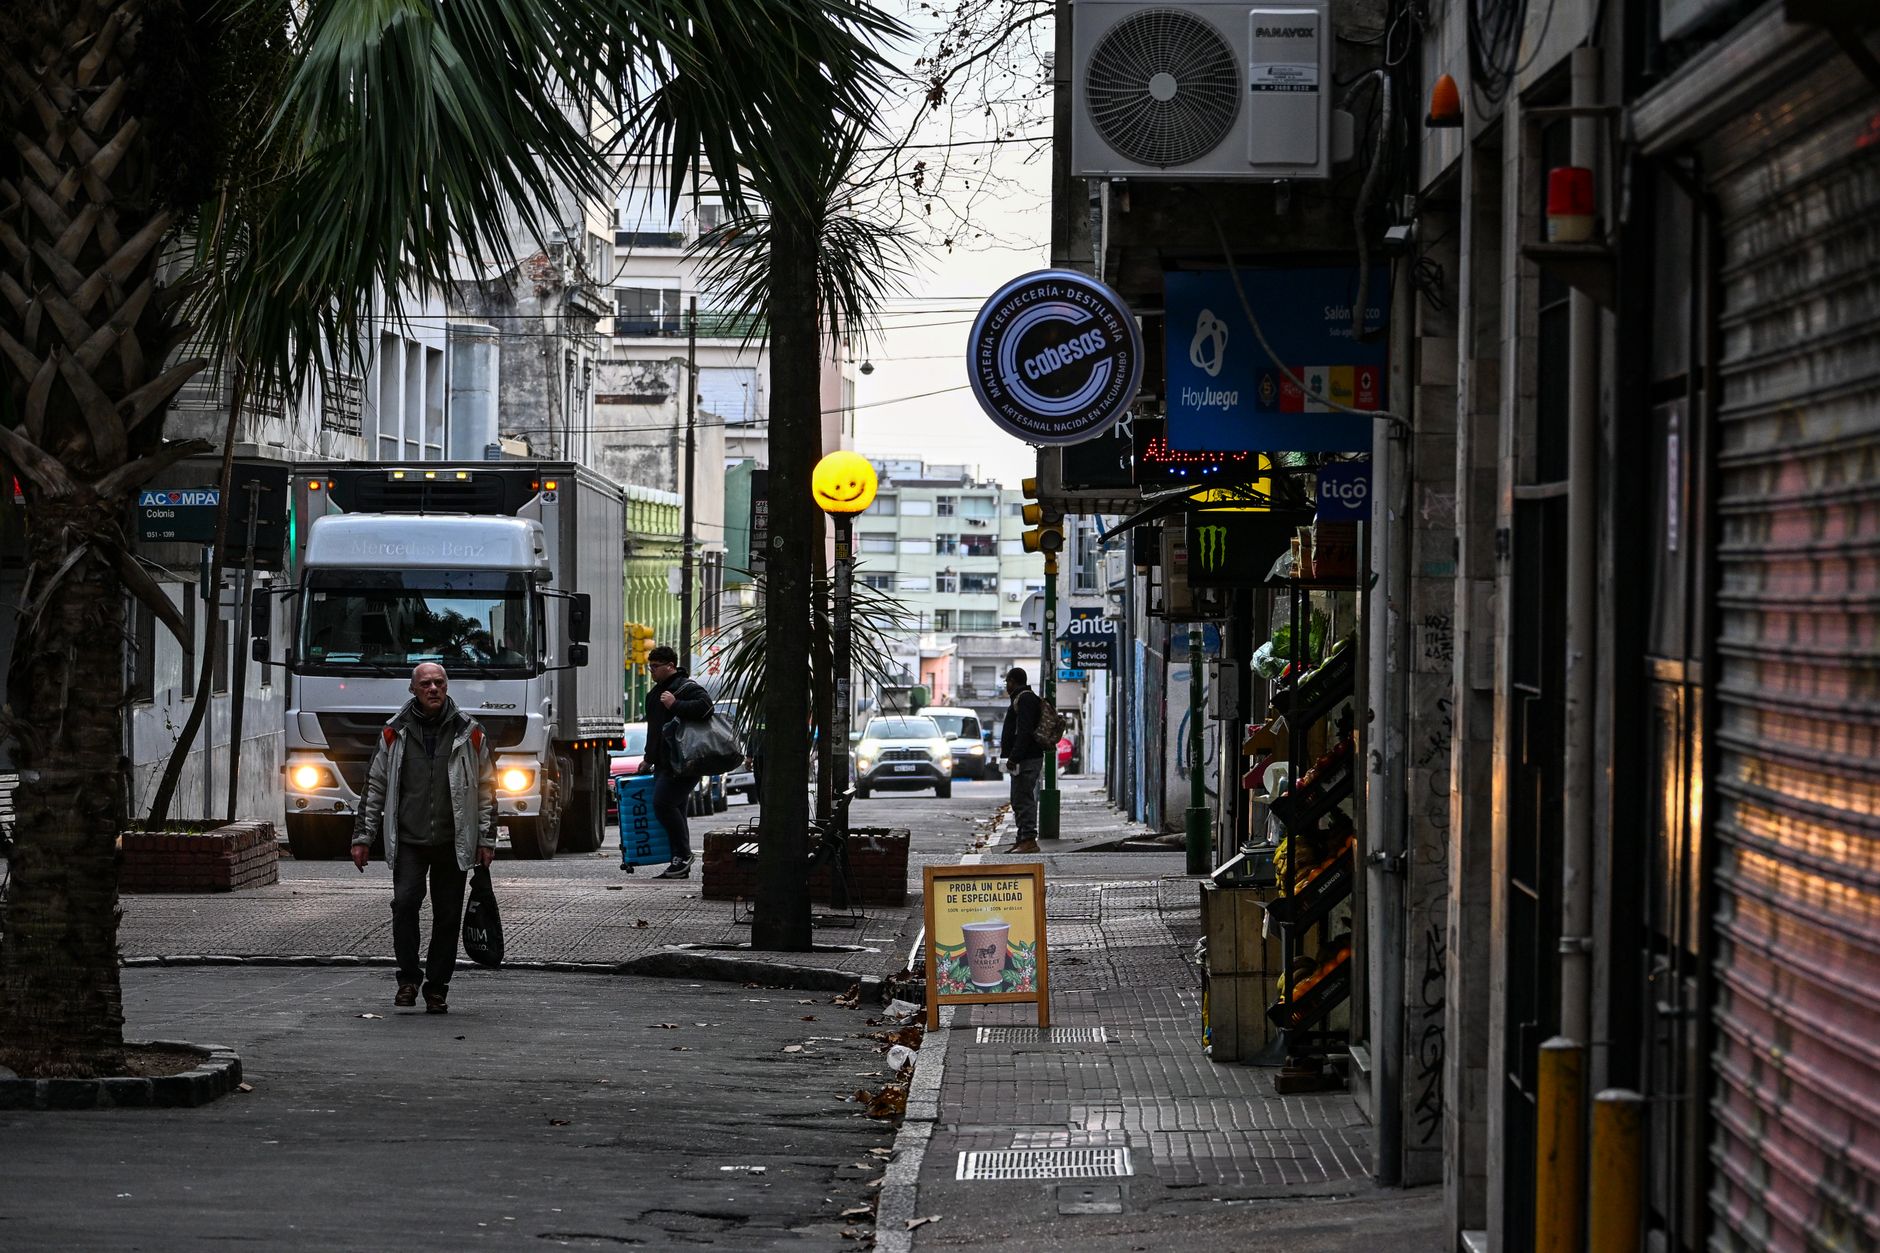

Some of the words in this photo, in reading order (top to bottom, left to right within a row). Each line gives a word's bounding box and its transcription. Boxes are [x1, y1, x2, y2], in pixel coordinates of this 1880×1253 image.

[1255, 27, 1314, 38] PANAVOX
[981, 335, 1001, 398] MALTERÍA
[991, 284, 1059, 330] CERVECERÍA
[1066, 288, 1124, 342] DESTILERÍA
[1024, 328, 1107, 380] cabesas
[1181, 386, 1239, 411] HoyJuega
[1001, 403, 1051, 432] ARTESANAL
[1053, 417, 1089, 432] NACIDA
[1089, 408, 1102, 421] EN
[146, 509, 175, 518] Colonia
[442, 540, 485, 557] Benz
[1077, 651, 1107, 660] Servicio
[632, 788, 653, 857] BUBBA
[949, 880, 977, 893] PROBÁ
[981, 881, 993, 891] UN
[996, 879, 1019, 891] CAFÉ
[947, 894, 957, 904] DE
[962, 892, 1023, 903] ESPECIALIDAD
